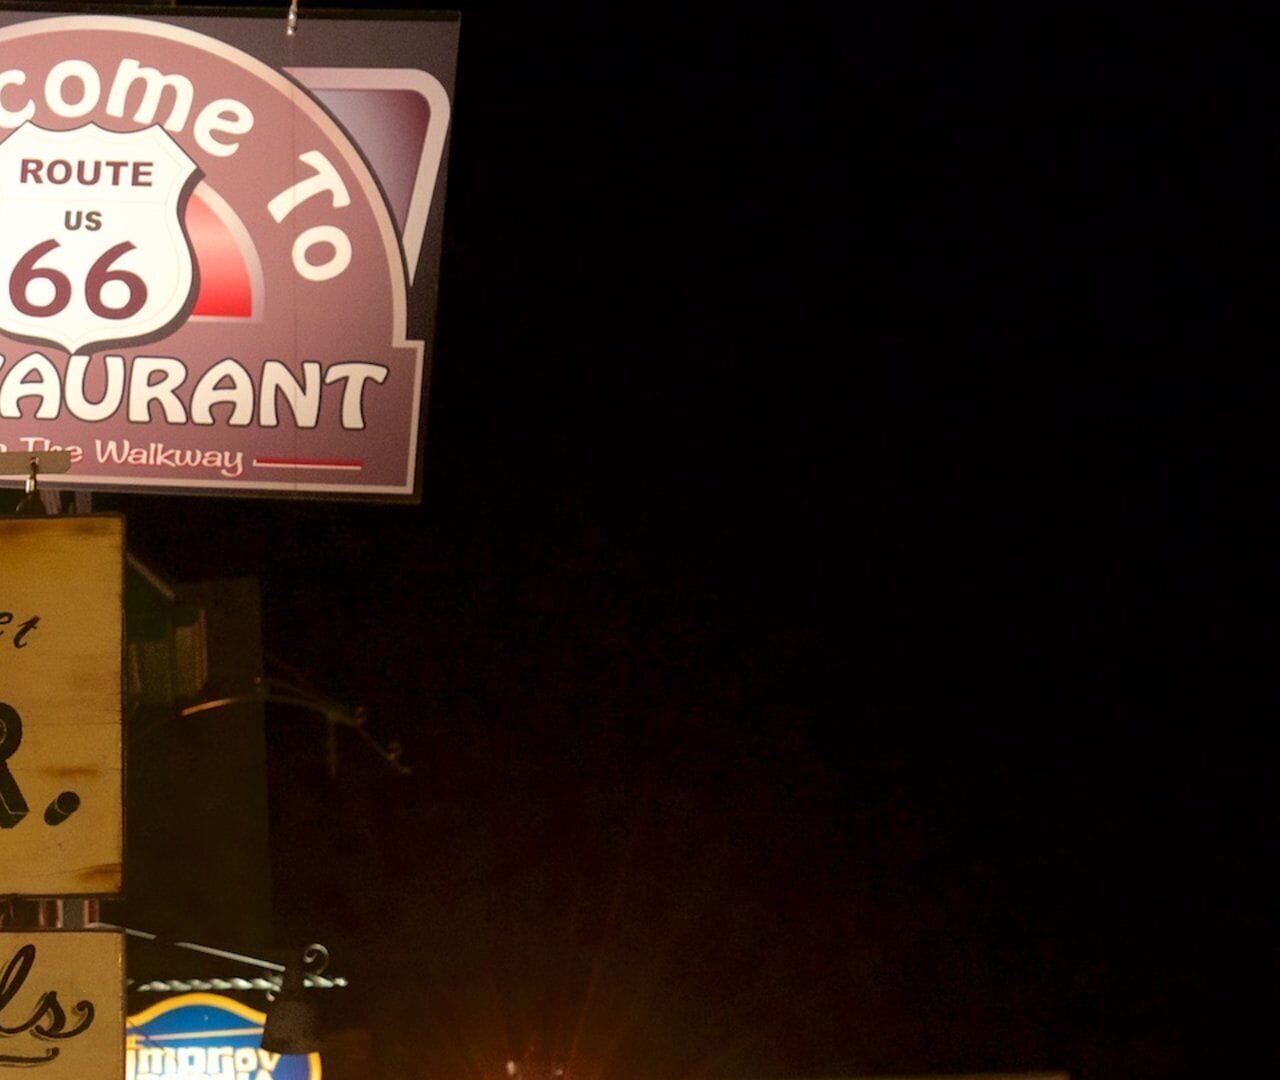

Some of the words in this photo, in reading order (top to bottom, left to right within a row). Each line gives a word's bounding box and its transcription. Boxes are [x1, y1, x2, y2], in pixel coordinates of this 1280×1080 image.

[18, 158, 154, 188] ROUTE
[63, 210, 103, 232] US
[267, 151, 353, 282] To
[7, 237, 149, 320] 66
[95, 439, 243, 477] Walkway
